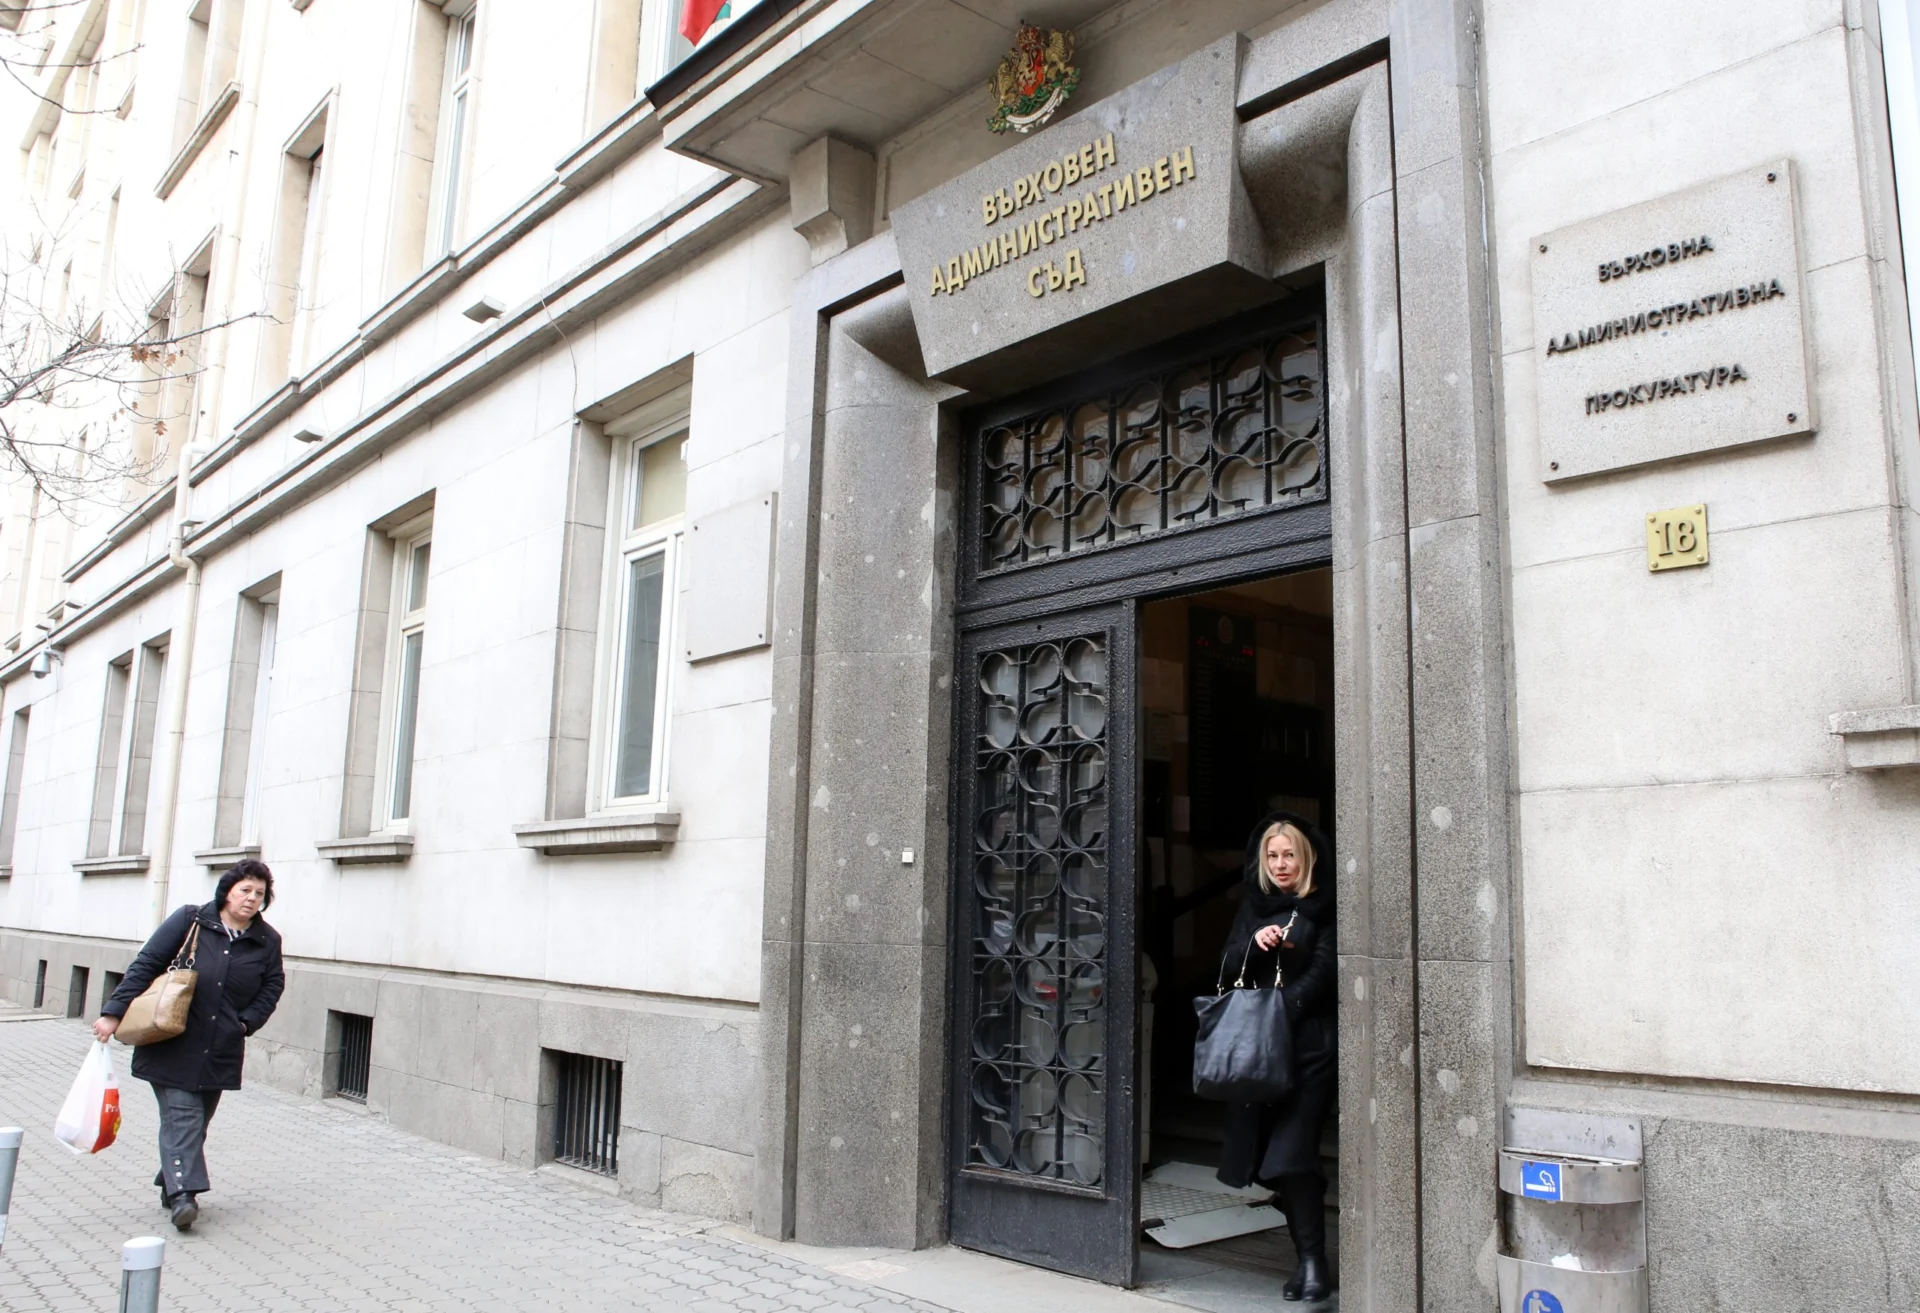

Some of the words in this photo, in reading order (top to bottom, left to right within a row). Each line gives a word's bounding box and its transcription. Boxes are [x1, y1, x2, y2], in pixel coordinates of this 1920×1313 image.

[982, 133, 1117, 226] ВЪРХОВЕН
[930, 145, 1196, 296] АДМИНИСТРАТИВЕН
[1027, 248, 1087, 298] СЪД
[1598, 234, 1714, 283] ВЪРХОВНА
[1546, 278, 1785, 356] АДМИНИСТРАТИВНА
[1585, 361, 1748, 415] ПРОКУРАТУРА
[1655, 519, 1697, 557] 18
